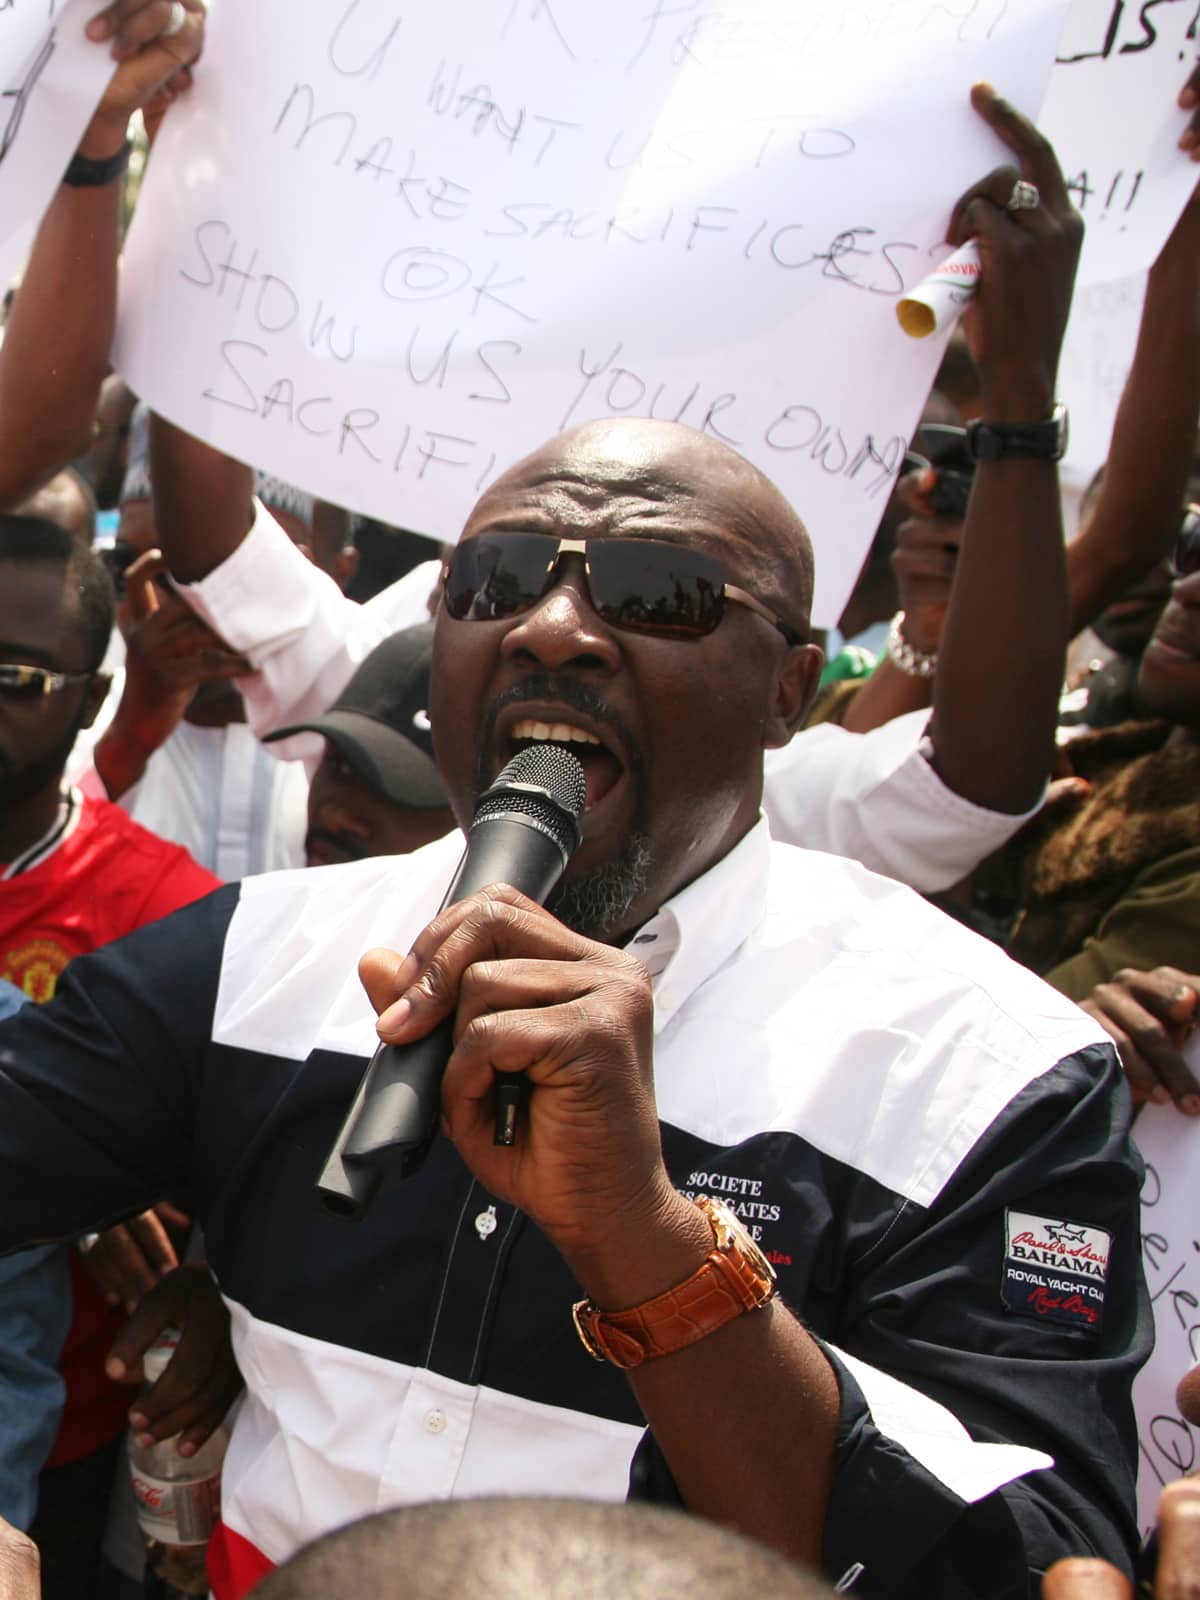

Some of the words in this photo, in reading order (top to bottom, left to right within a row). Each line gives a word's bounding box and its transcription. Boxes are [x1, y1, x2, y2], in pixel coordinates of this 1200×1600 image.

[273, 83, 472, 220] MAKE
[426, 56, 584, 168] WANT
[380, 247, 539, 323] OK
[178, 220, 360, 364] SHOW
[405, 326, 523, 404] US
[559, 342, 744, 447] YOUR
[686, 1172, 764, 1197] SOCIETE
[1006, 1268, 1048, 1288] ROYAL
[1047, 1279, 1089, 1296] YACHT
